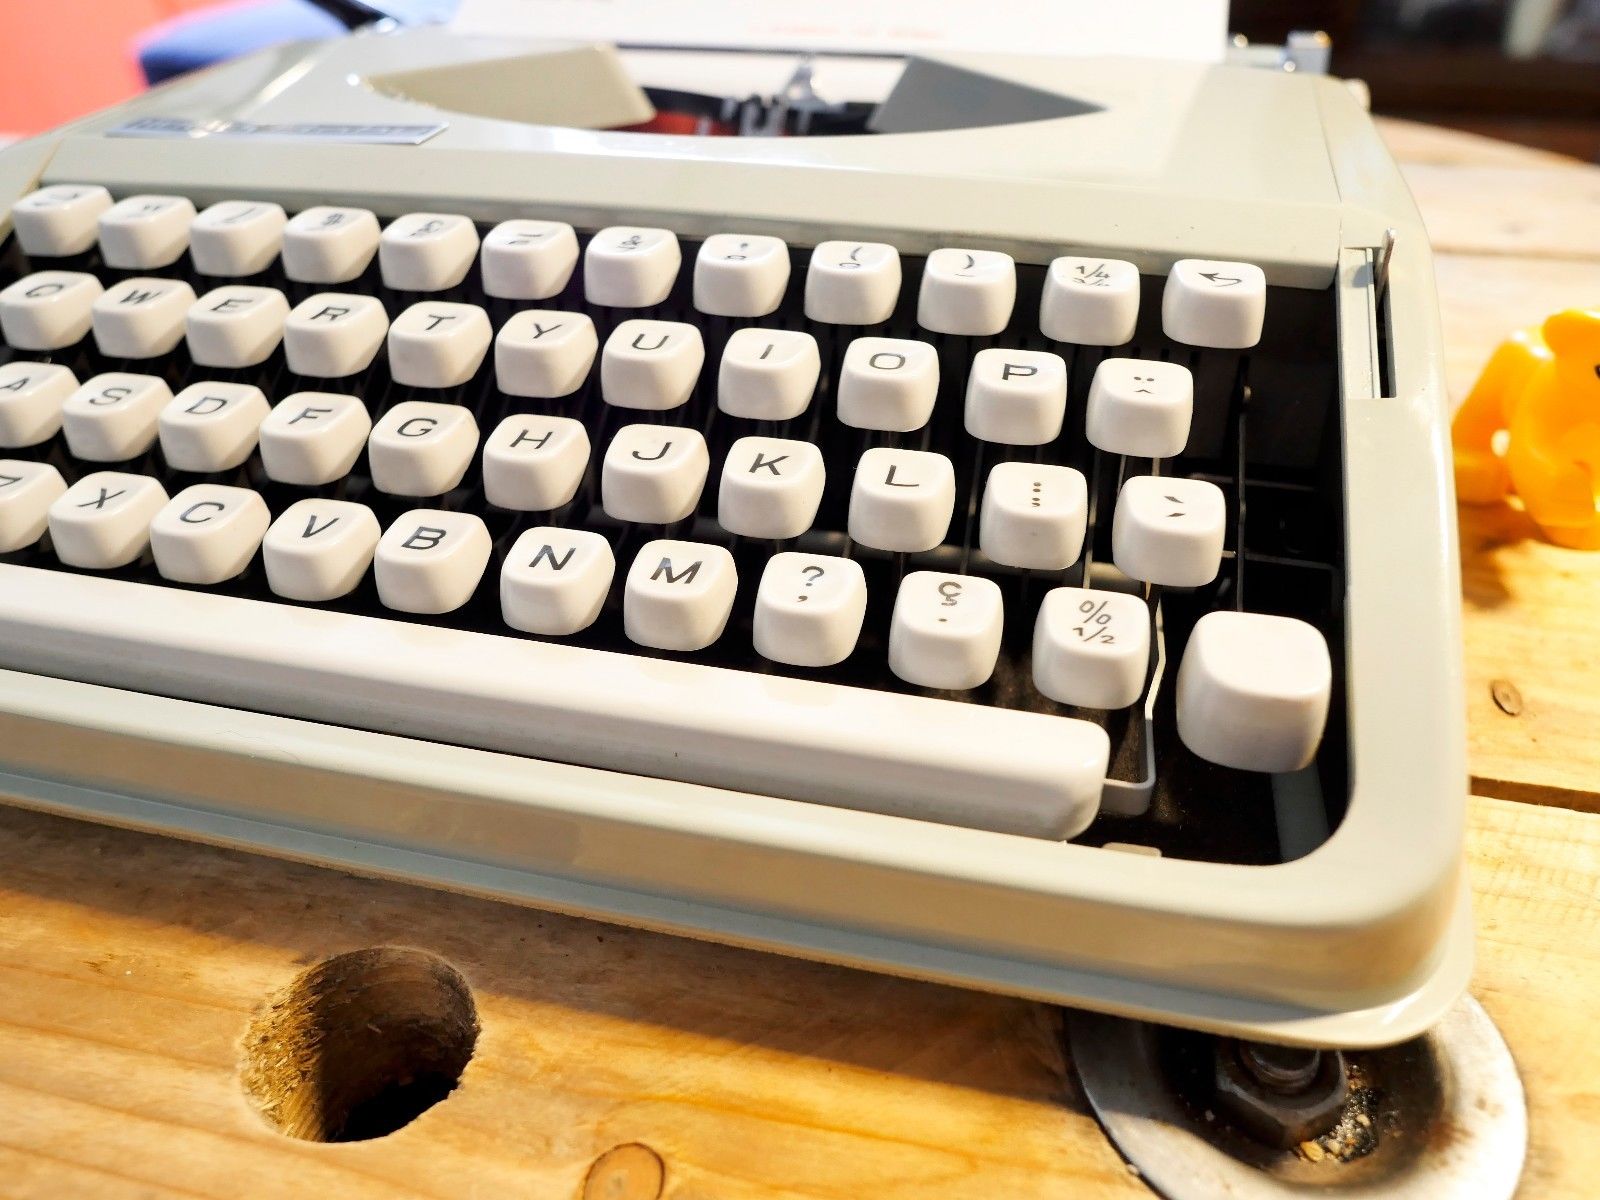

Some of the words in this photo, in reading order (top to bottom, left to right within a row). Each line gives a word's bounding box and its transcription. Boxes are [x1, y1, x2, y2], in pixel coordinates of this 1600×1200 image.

[121, 289, 160, 304] W
[211, 299, 252, 311] E
[310, 307, 350, 320] R
[426, 315, 456, 330] T
[533, 324, 562, 338] Y
[632, 334, 669, 350] U
[869, 353, 905, 370] O
[1002, 364, 1037, 380] P
[0, 378, 29, 391] A
[89, 388, 132, 405] S
[185, 397, 227, 414] D
[288, 408, 332, 424] F
[397, 418, 437, 436] G
[510, 430, 553, 449] H
[632, 442, 672, 460] J
[749, 453, 789, 475] K
[885, 465, 919, 487] L
[78, 488, 125, 509] X
[180, 502, 225, 523] C
[302, 515, 339, 538] V
[401, 527, 446, 550] B
[529, 545, 576, 570] N
[650, 558, 702, 584] M
[802, 566, 824, 586] ?
